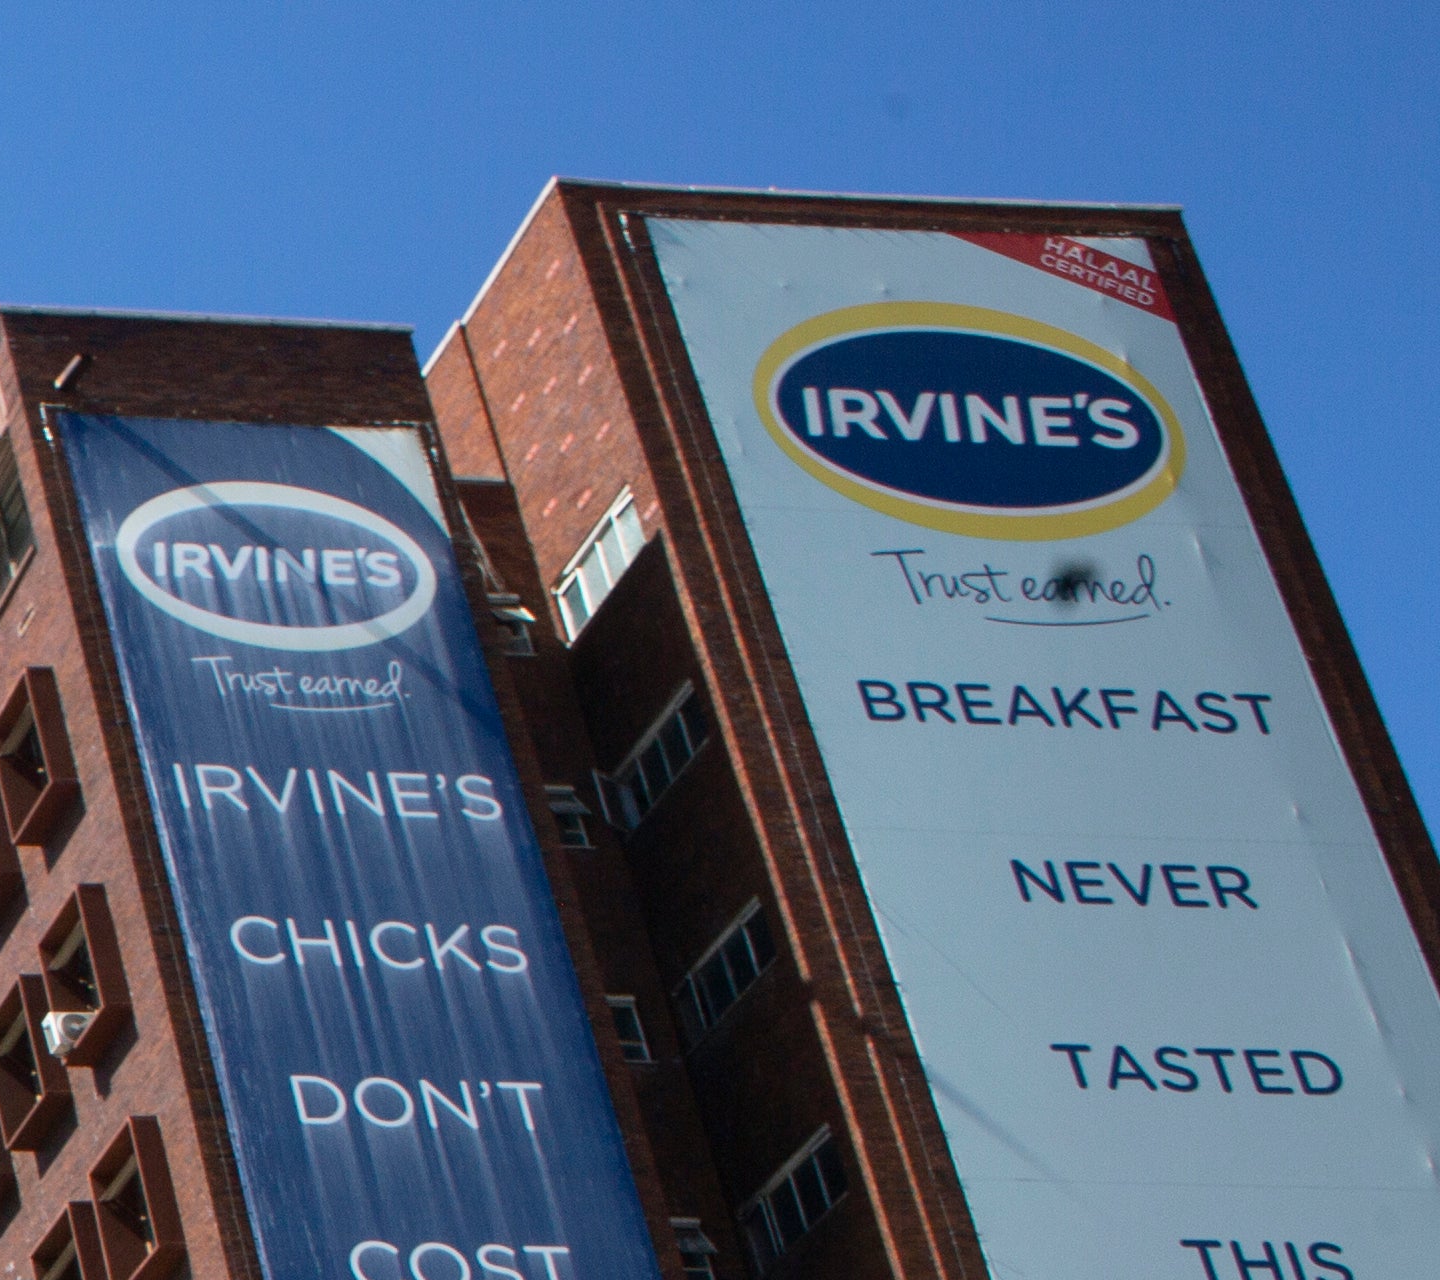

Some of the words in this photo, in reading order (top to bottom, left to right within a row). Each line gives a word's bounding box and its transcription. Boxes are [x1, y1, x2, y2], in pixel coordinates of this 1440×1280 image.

[1040, 253, 1155, 306] CERTIFIED
[1044, 236, 1157, 294] HALAAL
[802, 385, 1141, 450] IRVINE'S
[152, 541, 403, 589] IRVINE'S
[870, 549, 1012, 605] Trust
[190, 656, 294, 697] Trust
[857, 679, 1273, 736] BREAKFAST
[173, 763, 503, 821] IRVINE'S
[1008, 859, 1260, 910] NEVER
[229, 915, 529, 975] CHICKS
[1049, 1044, 1343, 1096] TASTED
[289, 1074, 542, 1131] DON'T
